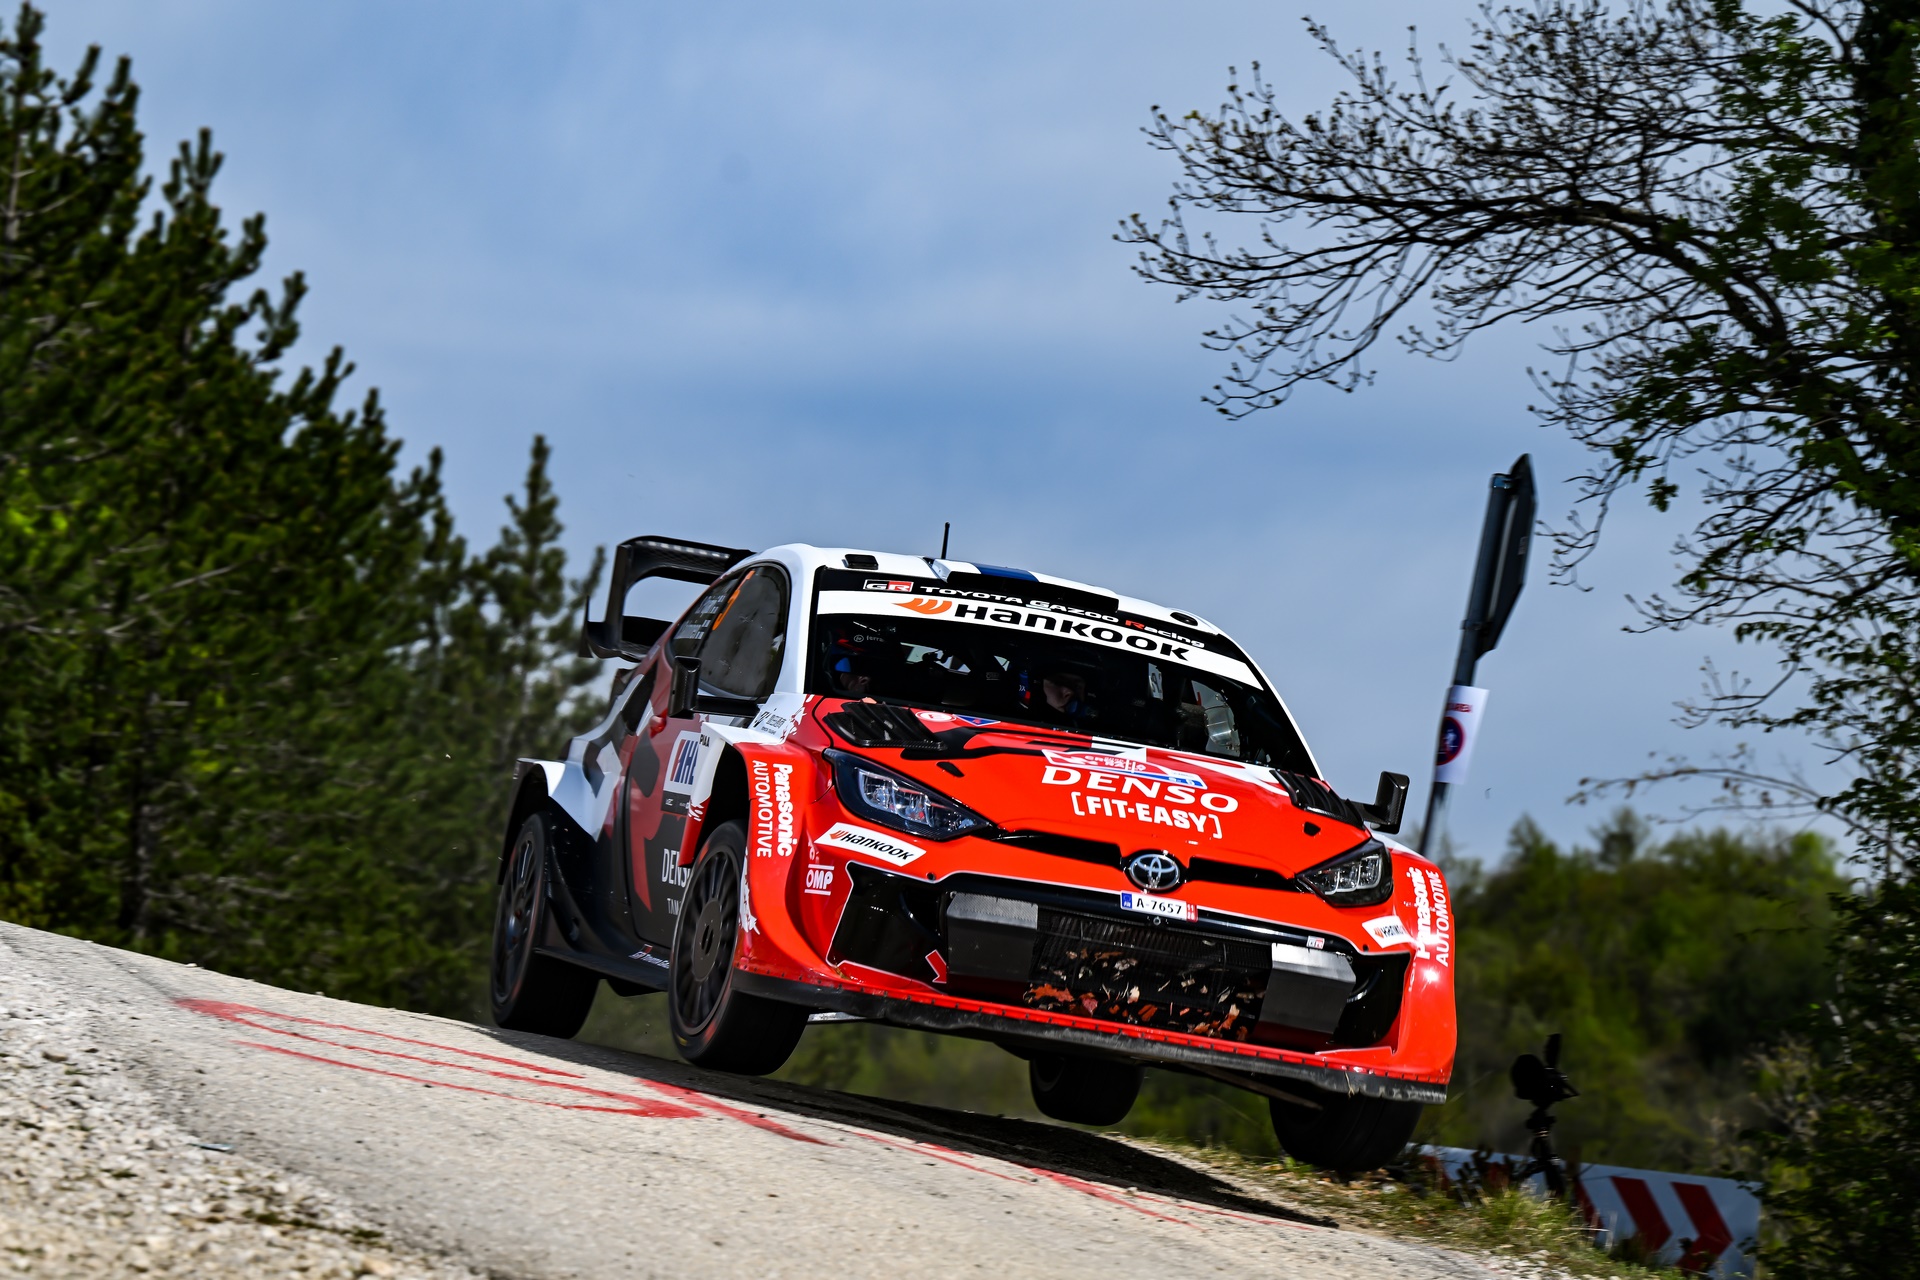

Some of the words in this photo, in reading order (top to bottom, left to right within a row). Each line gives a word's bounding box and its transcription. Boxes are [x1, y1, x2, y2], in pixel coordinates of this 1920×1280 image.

[920, 586, 1023, 604] TOYOTA
[1027, 600, 1119, 623] GAZOO
[1125, 619, 1205, 649] Racing
[752, 760, 773, 858] AUTOMOTIVE
[773, 763, 797, 857] Panasonic
[1041, 765, 1239, 814] DENSO
[805, 867, 834, 891] OMP
